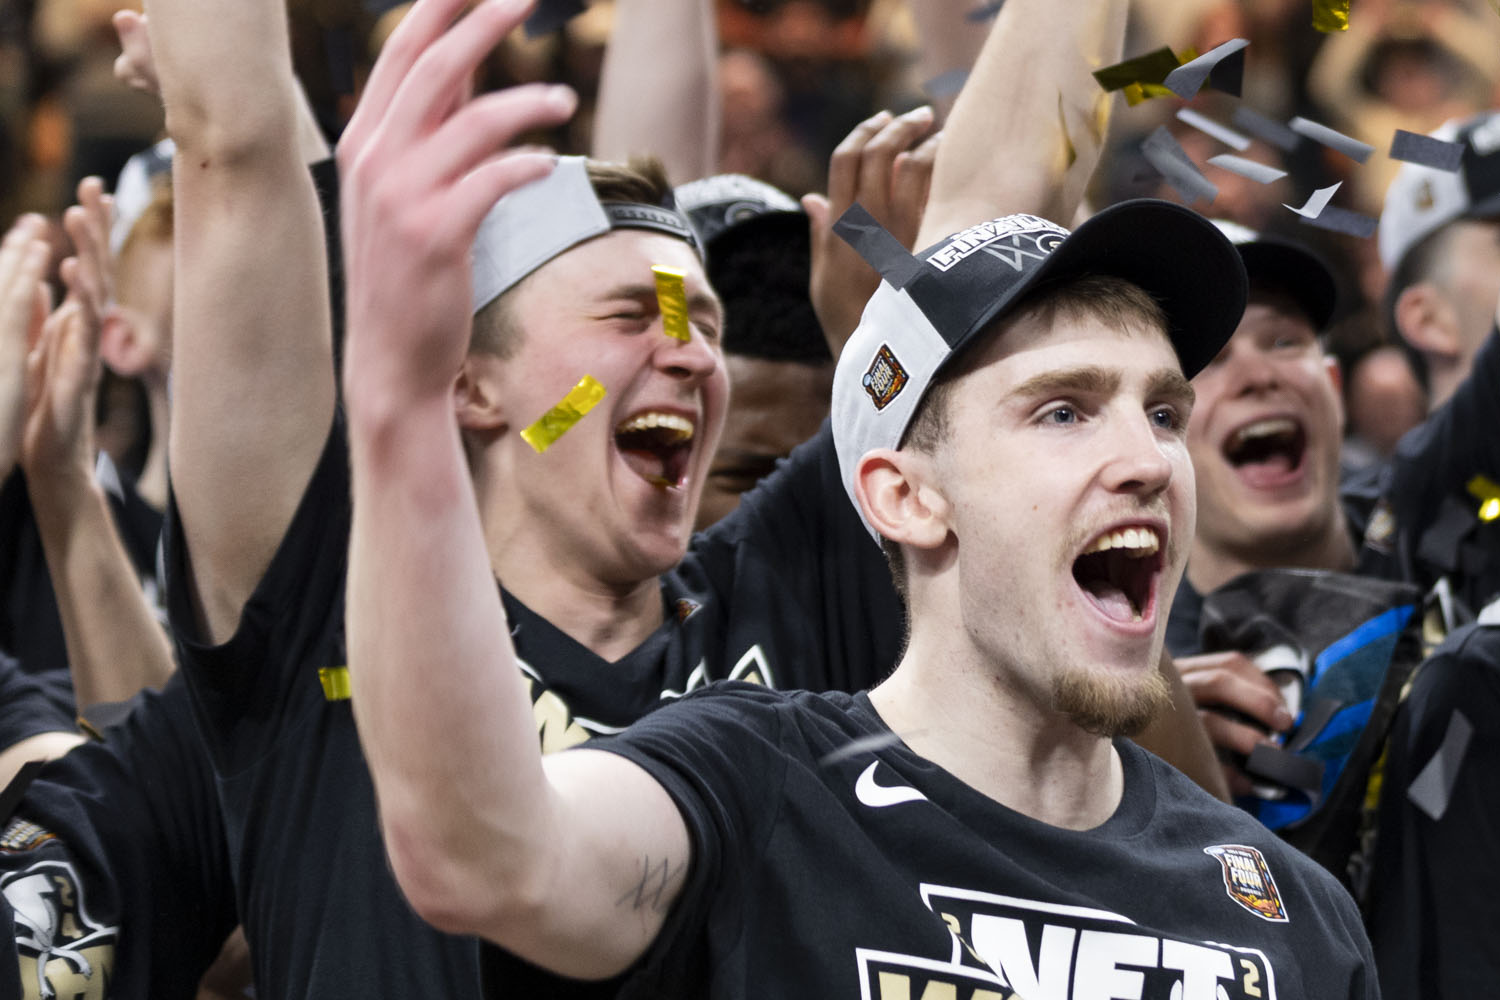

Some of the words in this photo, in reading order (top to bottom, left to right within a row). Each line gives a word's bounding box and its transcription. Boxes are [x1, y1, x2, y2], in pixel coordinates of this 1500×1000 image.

[1223, 853, 1260, 875] FINAL
[1230, 866, 1263, 889] FOUR
[971, 913, 1236, 1000] NET
